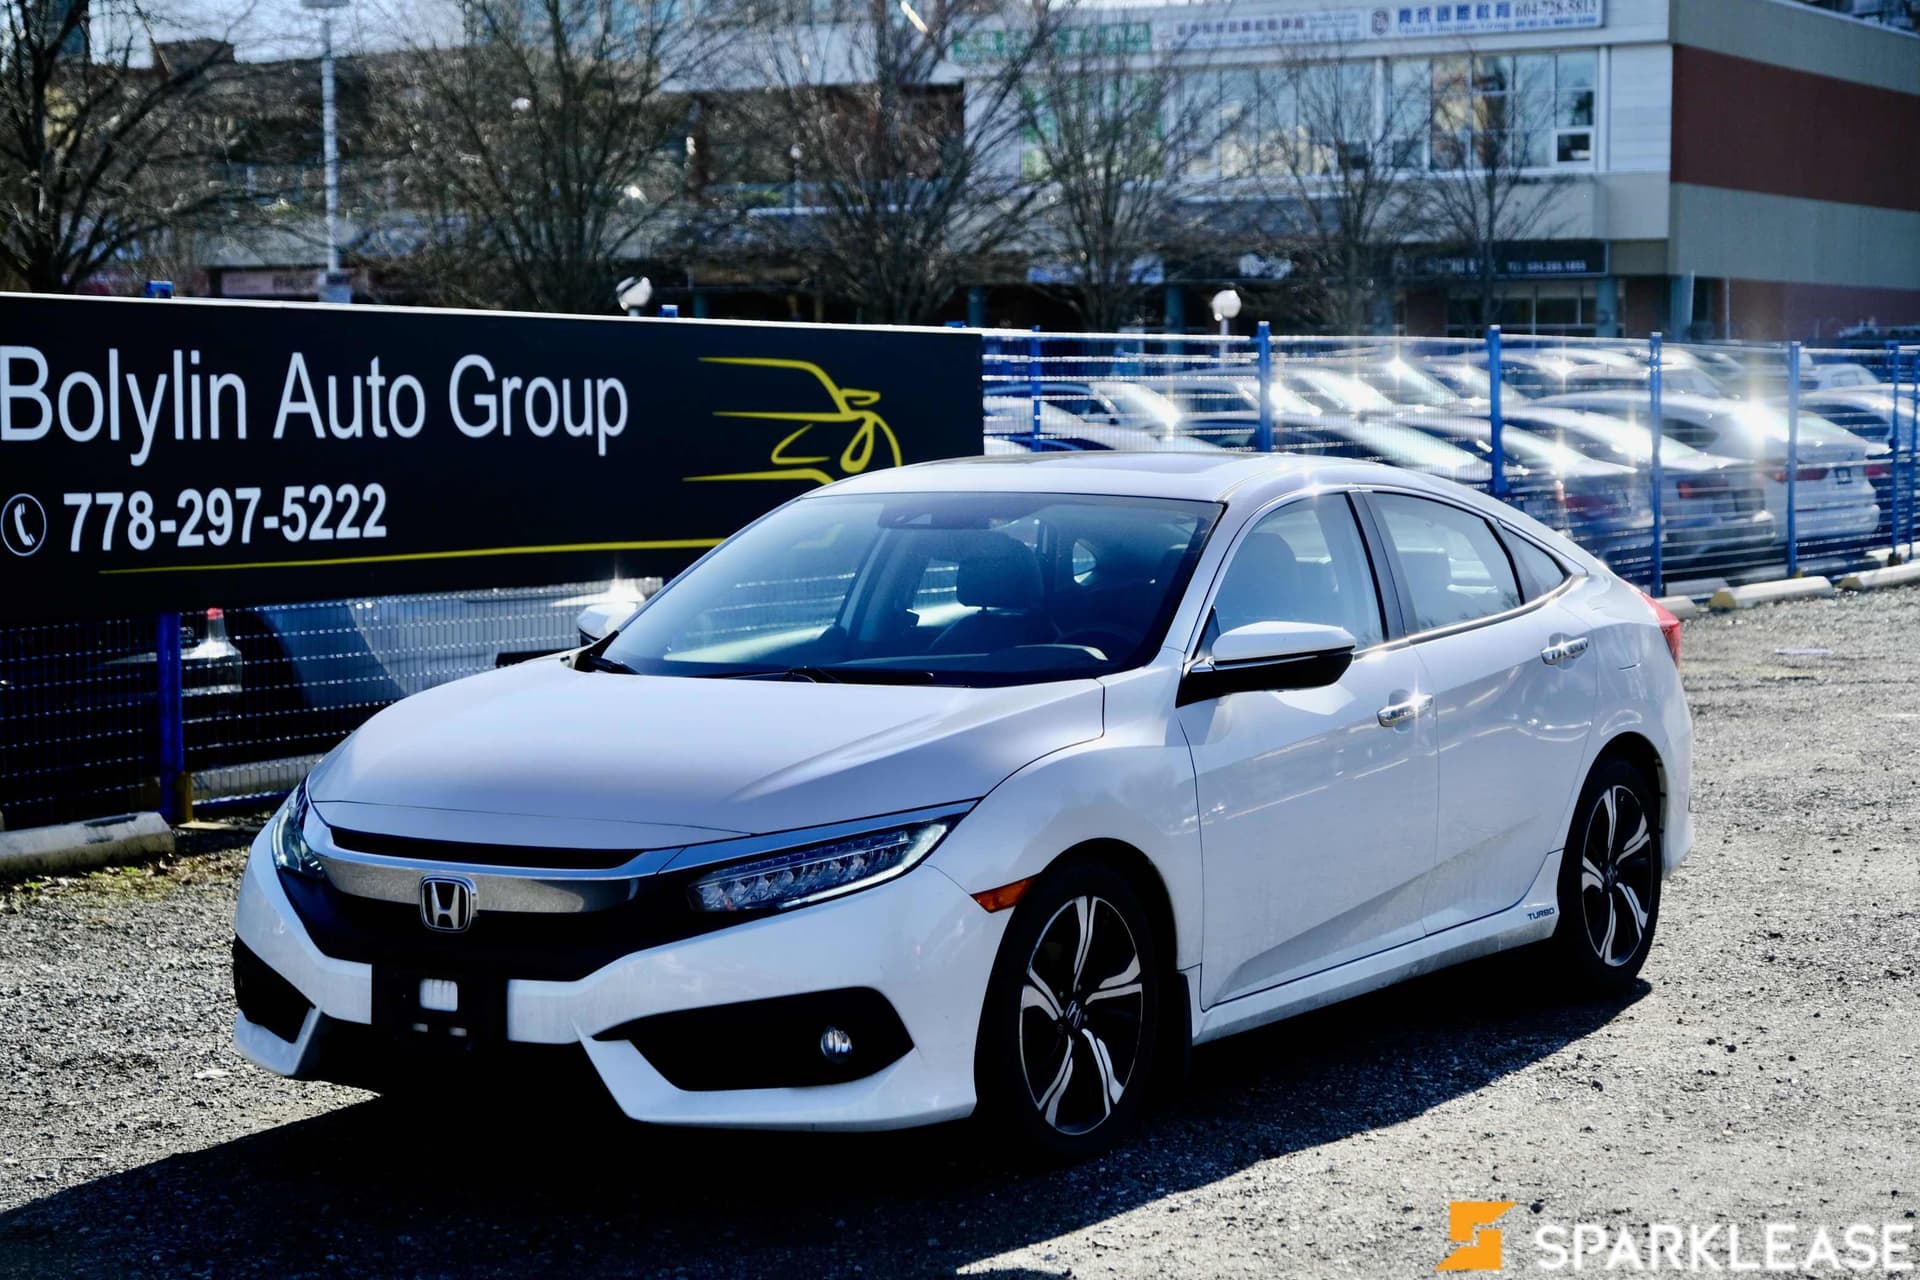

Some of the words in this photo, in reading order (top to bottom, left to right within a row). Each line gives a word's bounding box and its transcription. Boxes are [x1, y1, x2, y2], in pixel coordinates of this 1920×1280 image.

[0, 345, 248, 466] Bolylin
[272, 352, 427, 439] Auto
[449, 354, 629, 457] Group
[63, 483, 388, 553] 778-297-5222
[1527, 907, 1556, 920] TURBO
